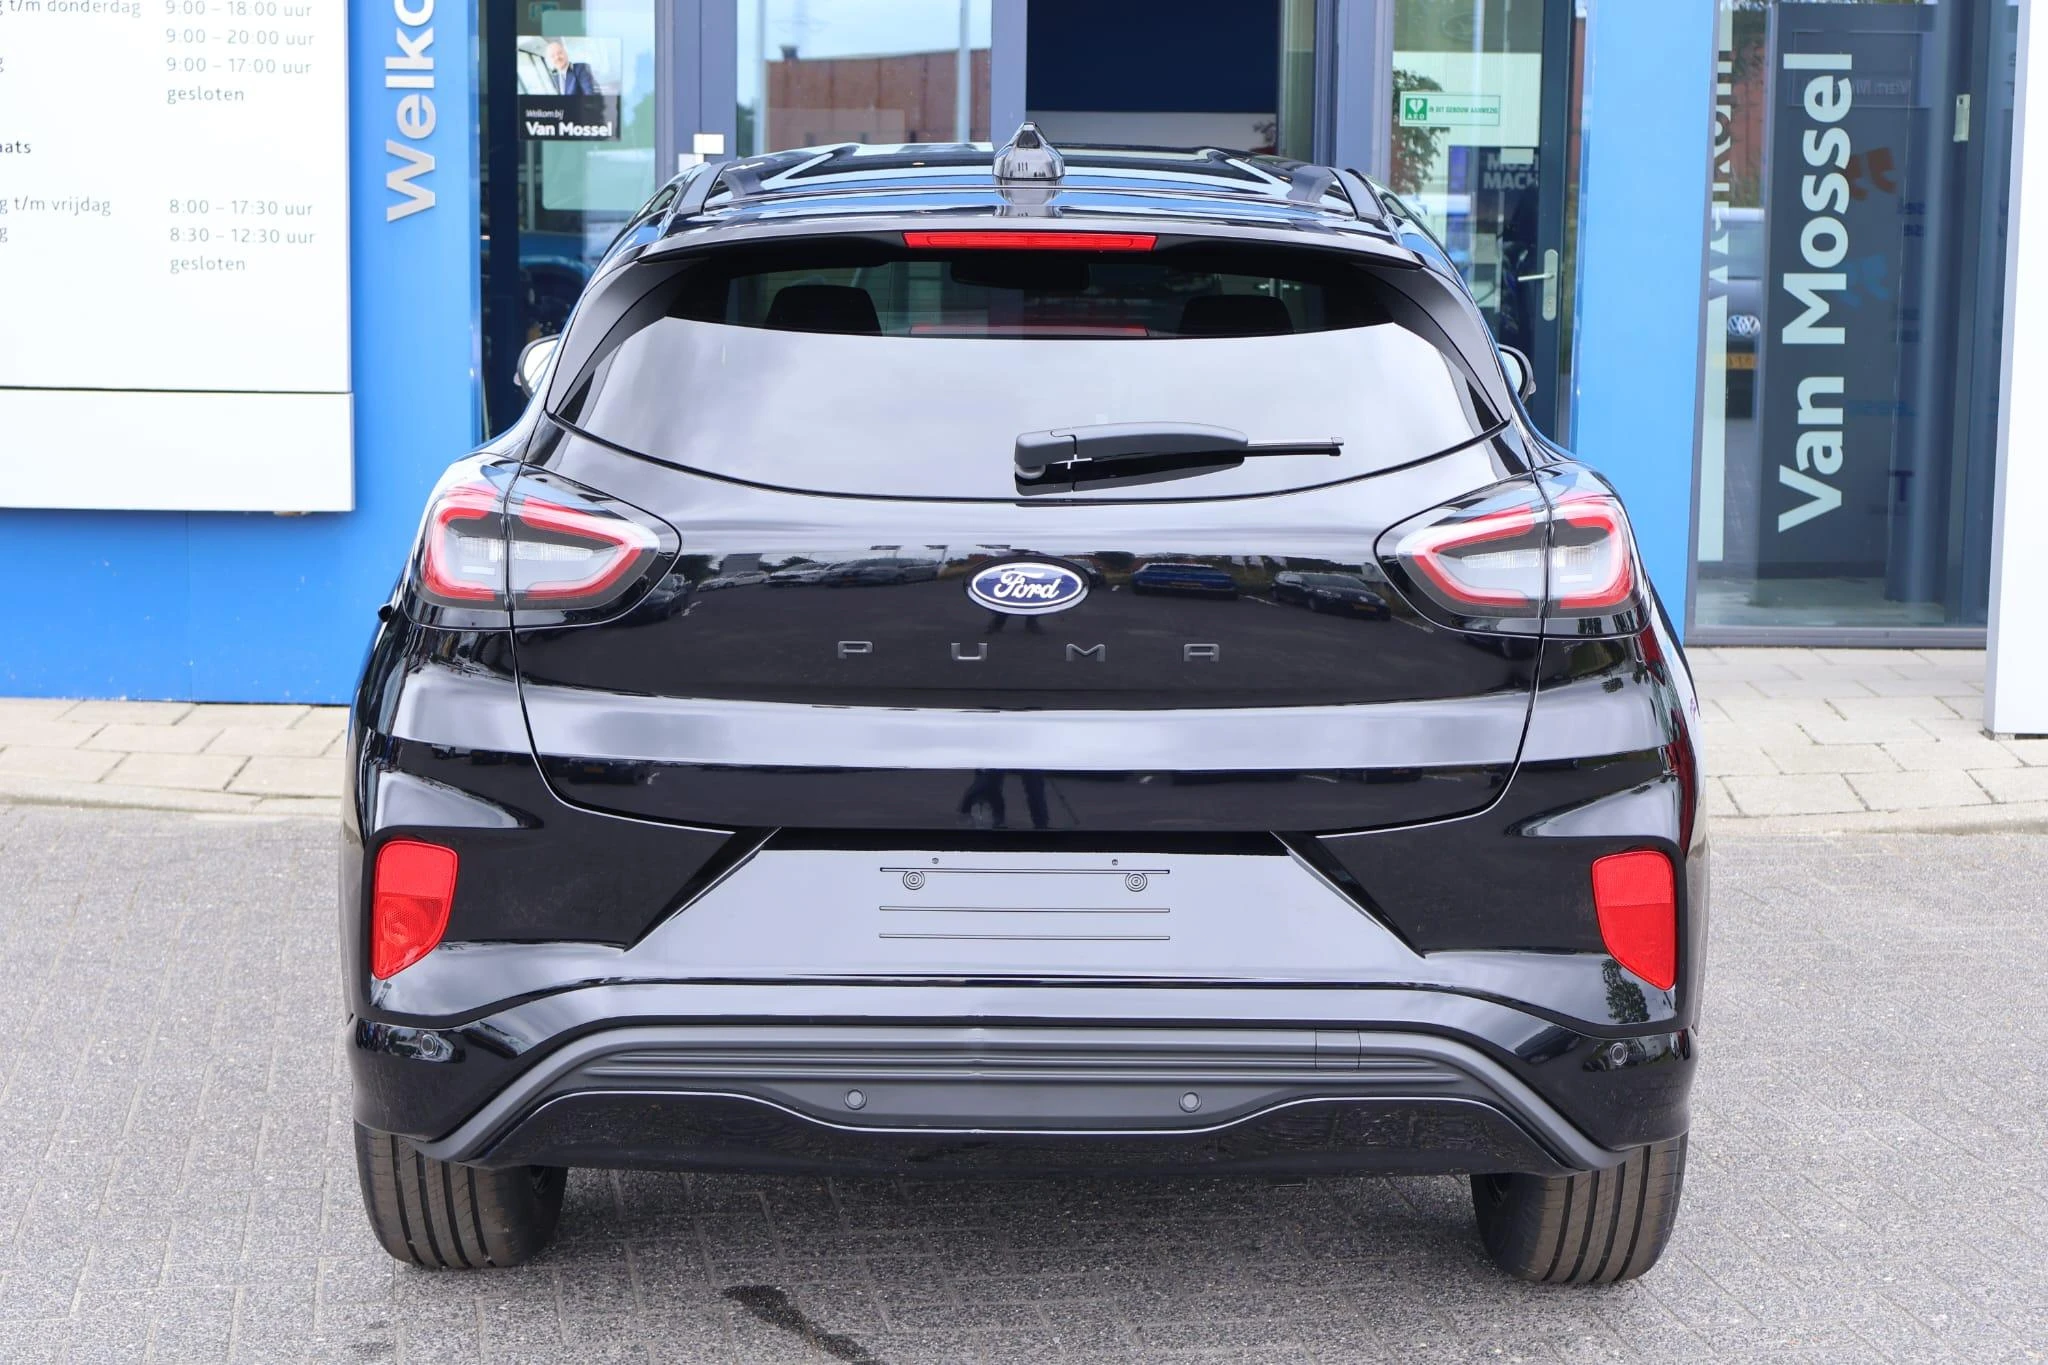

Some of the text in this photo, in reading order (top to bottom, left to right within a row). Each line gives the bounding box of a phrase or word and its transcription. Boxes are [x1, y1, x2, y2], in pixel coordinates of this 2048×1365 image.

[47, 0, 142, 19] donderdag
[227, 0, 277, 16] 18:00
[284, 5, 312, 16] uur
[166, 28, 206, 44] 9:00
[227, 29, 279, 45] 20:00
[286, 34, 315, 46] uur
[166, 57, 207, 72] 9:00
[228, 57, 277, 73] 17:00
[283, 63, 312, 74] uur
[167, 85, 244, 106] gesloten
[526, 122, 612, 136] Van Mossel
[14, 195, 45, 212] t/m
[51, 195, 112, 217] vrijdag
[169, 198, 209, 215] 8:00
[232, 200, 278, 215] 17:30
[285, 204, 313, 217] uur
[170, 227, 209, 243] 8:30
[232, 228, 280, 244] 12:30
[286, 232, 315, 245] uur
[170, 256, 247, 275] gesloten
[1777, 53, 1853, 533] Van Mossel
[993, 570, 1061, 600] Ford
